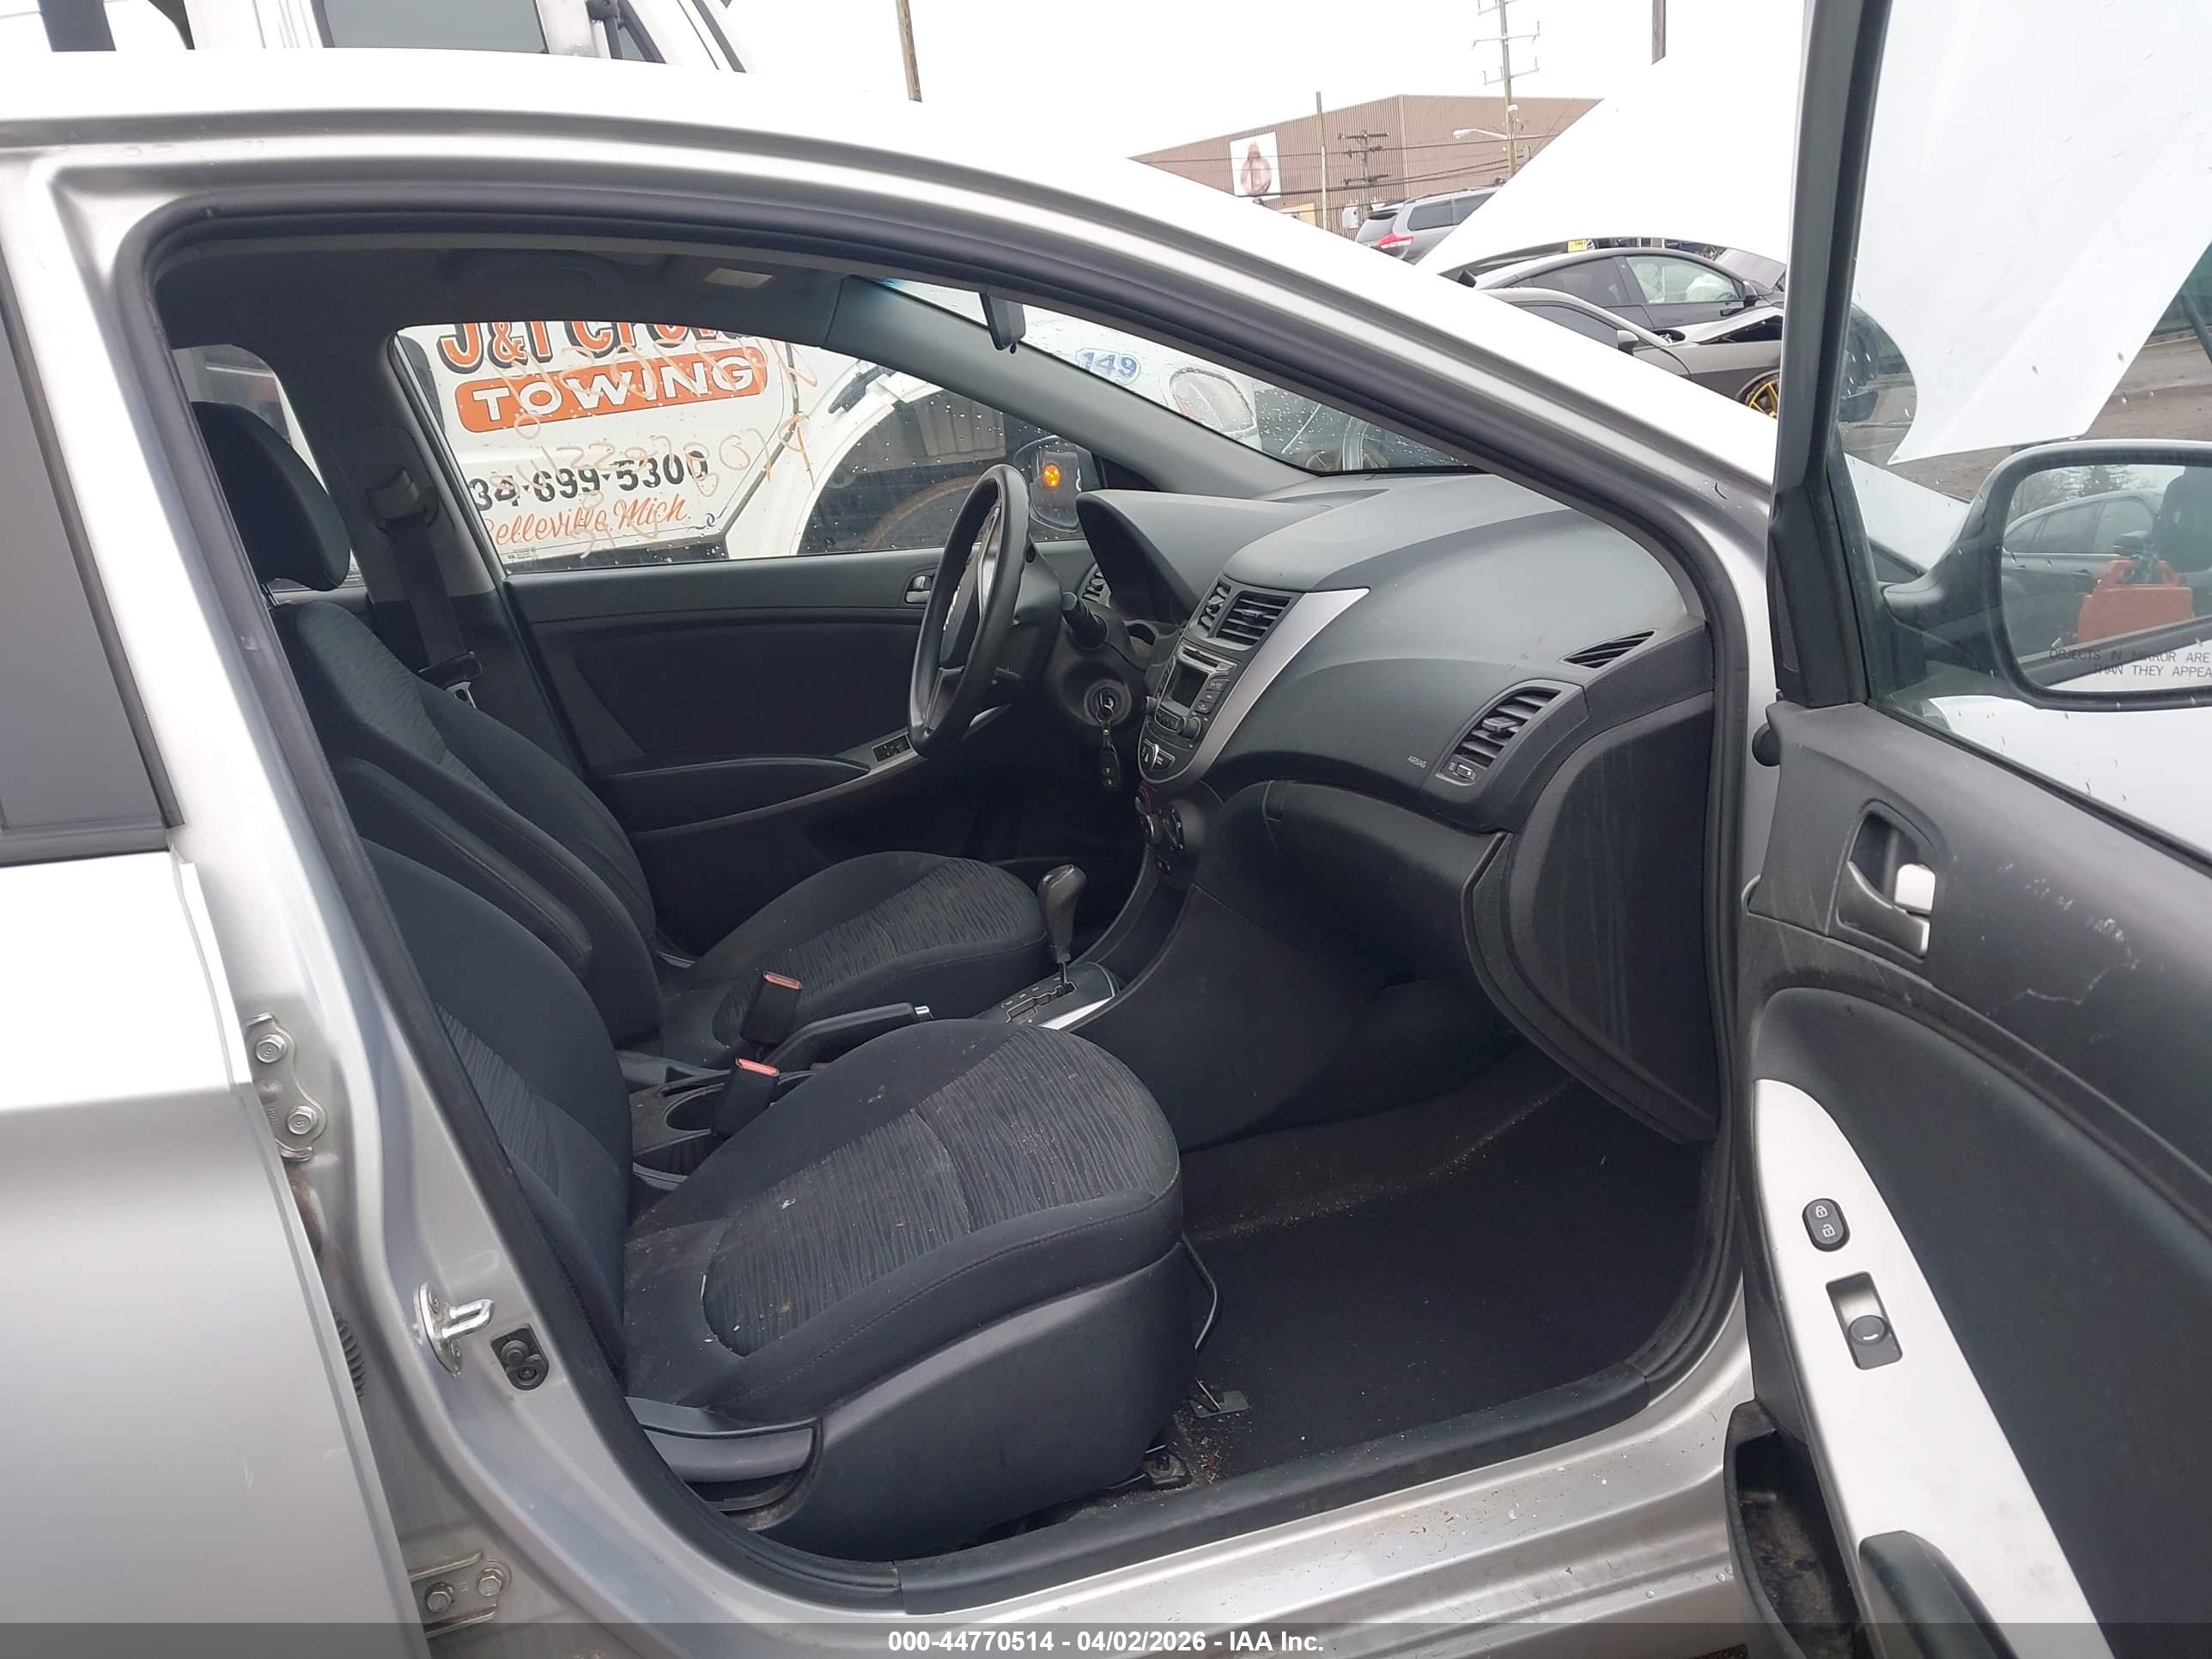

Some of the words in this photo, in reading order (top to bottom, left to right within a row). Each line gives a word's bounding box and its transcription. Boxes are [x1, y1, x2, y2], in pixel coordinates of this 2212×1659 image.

[1084, 351, 1138, 378] 149
[472, 356, 754, 422] TOWING
[2049, 647, 2101, 660] OBJECTS
[2111, 650, 2123, 660] IN
[2185, 652, 2211, 663] ARE
[2132, 665, 2164, 676] THEY
